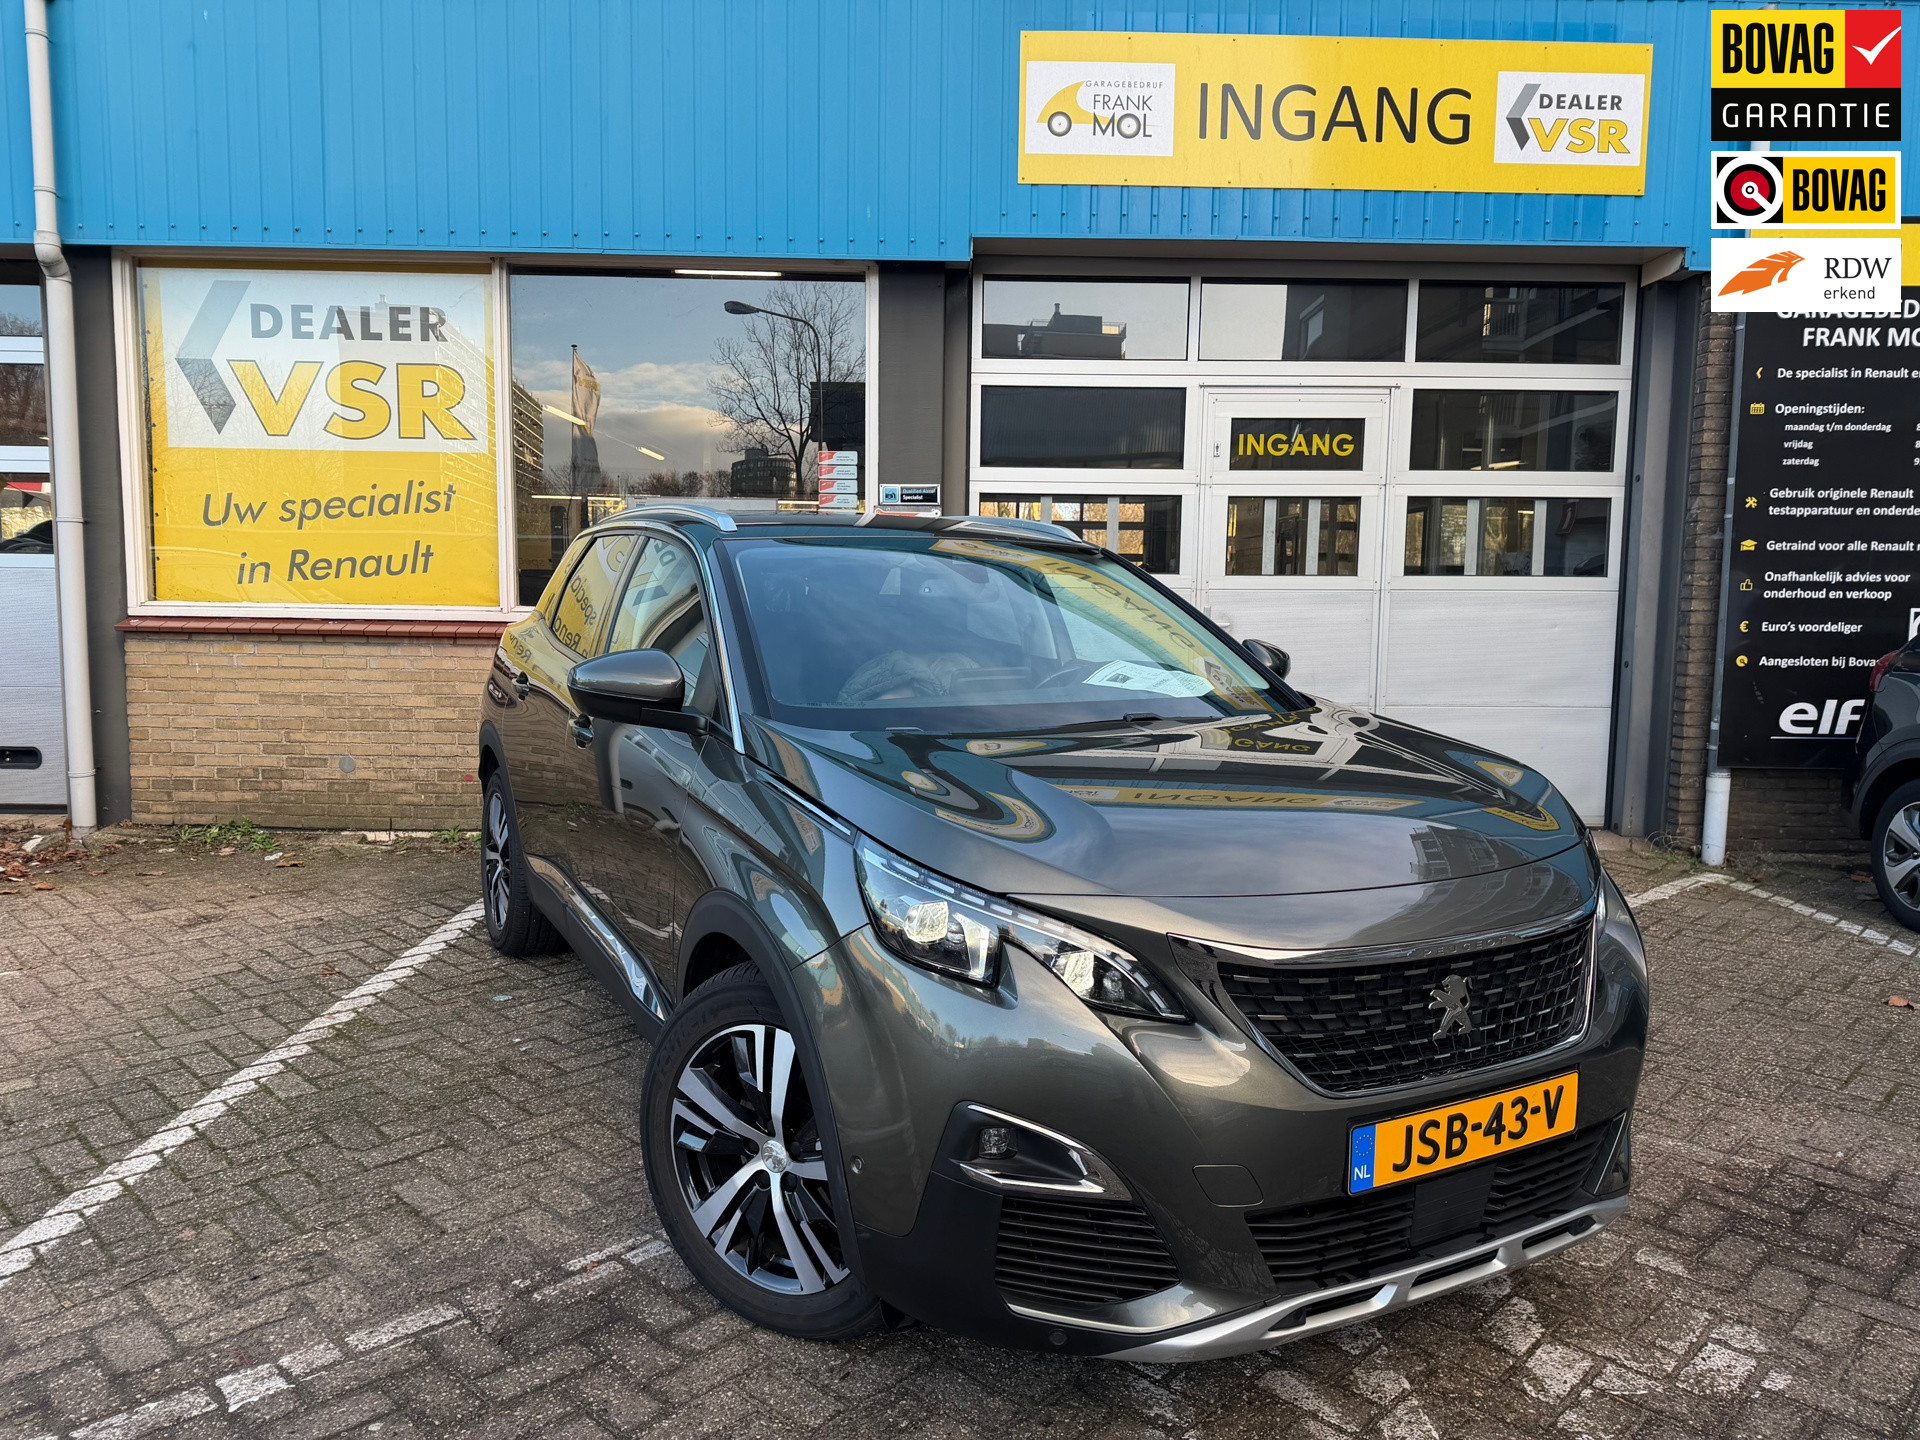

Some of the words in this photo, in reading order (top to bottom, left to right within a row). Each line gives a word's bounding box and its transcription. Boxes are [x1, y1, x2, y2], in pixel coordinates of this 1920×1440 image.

[1093, 94, 1152, 111] FRANK
[1539, 93, 1622, 111] DEALER
[1198, 82, 1472, 146] INGANG
[1093, 112, 1152, 139] MOL
[1528, 117, 1630, 154] VSR
[250, 303, 448, 343] DEALER
[1802, 327, 1881, 347] FRANK
[1777, 367, 1793, 379] De
[1795, 367, 1848, 381] specialist
[1850, 367, 1862, 379] in
[1864, 367, 1909, 379] Renault
[1912, 369, 1920, 379] e
[226, 359, 478, 441] VSR
[1775, 402, 1865, 416] Openingstijden:
[1784, 422, 1824, 433] maandag
[1825, 422, 1843, 432] t/m
[1845, 422, 1891, 433] donderdag
[1238, 433, 1355, 457] INGANG
[1783, 439, 1813, 450] vrijdag
[1782, 456, 1820, 467] zaterdag
[1769, 487, 1815, 499] Gebruik
[1817, 487, 1867, 501] originele
[1870, 487, 1914, 499] Renault
[202, 492, 267, 526] Uw
[279, 479, 456, 530] specialist
[1768, 505, 1853, 517] testapparatuur
[1856, 507, 1870, 516] en
[1766, 540, 1816, 551] Getraind
[1818, 542, 1846, 551] voor
[1847, 540, 1868, 551] alle
[1871, 540, 1914, 552] Renault
[237, 552, 271, 585] in
[287, 540, 434, 582] Renault
[1764, 571, 1843, 584] Onafhankelijk
[1845, 571, 1882, 583] advies
[1883, 573, 1910, 583] voor
[1763, 588, 1826, 599] onderhoud
[1828, 590, 1843, 599] en
[1845, 588, 1892, 602] verkoop
[1798, 621, 1863, 635] voordeliger
[1758, 656, 1829, 669] Aangesloten
[1831, 656, 1846, 669] bij
[1848, 656, 1878, 667] Bova
[1778, 699, 1865, 734] elf
[1392, 1085, 1564, 1172] JSB-43-V
[1353, 1164, 1371, 1181] NL
